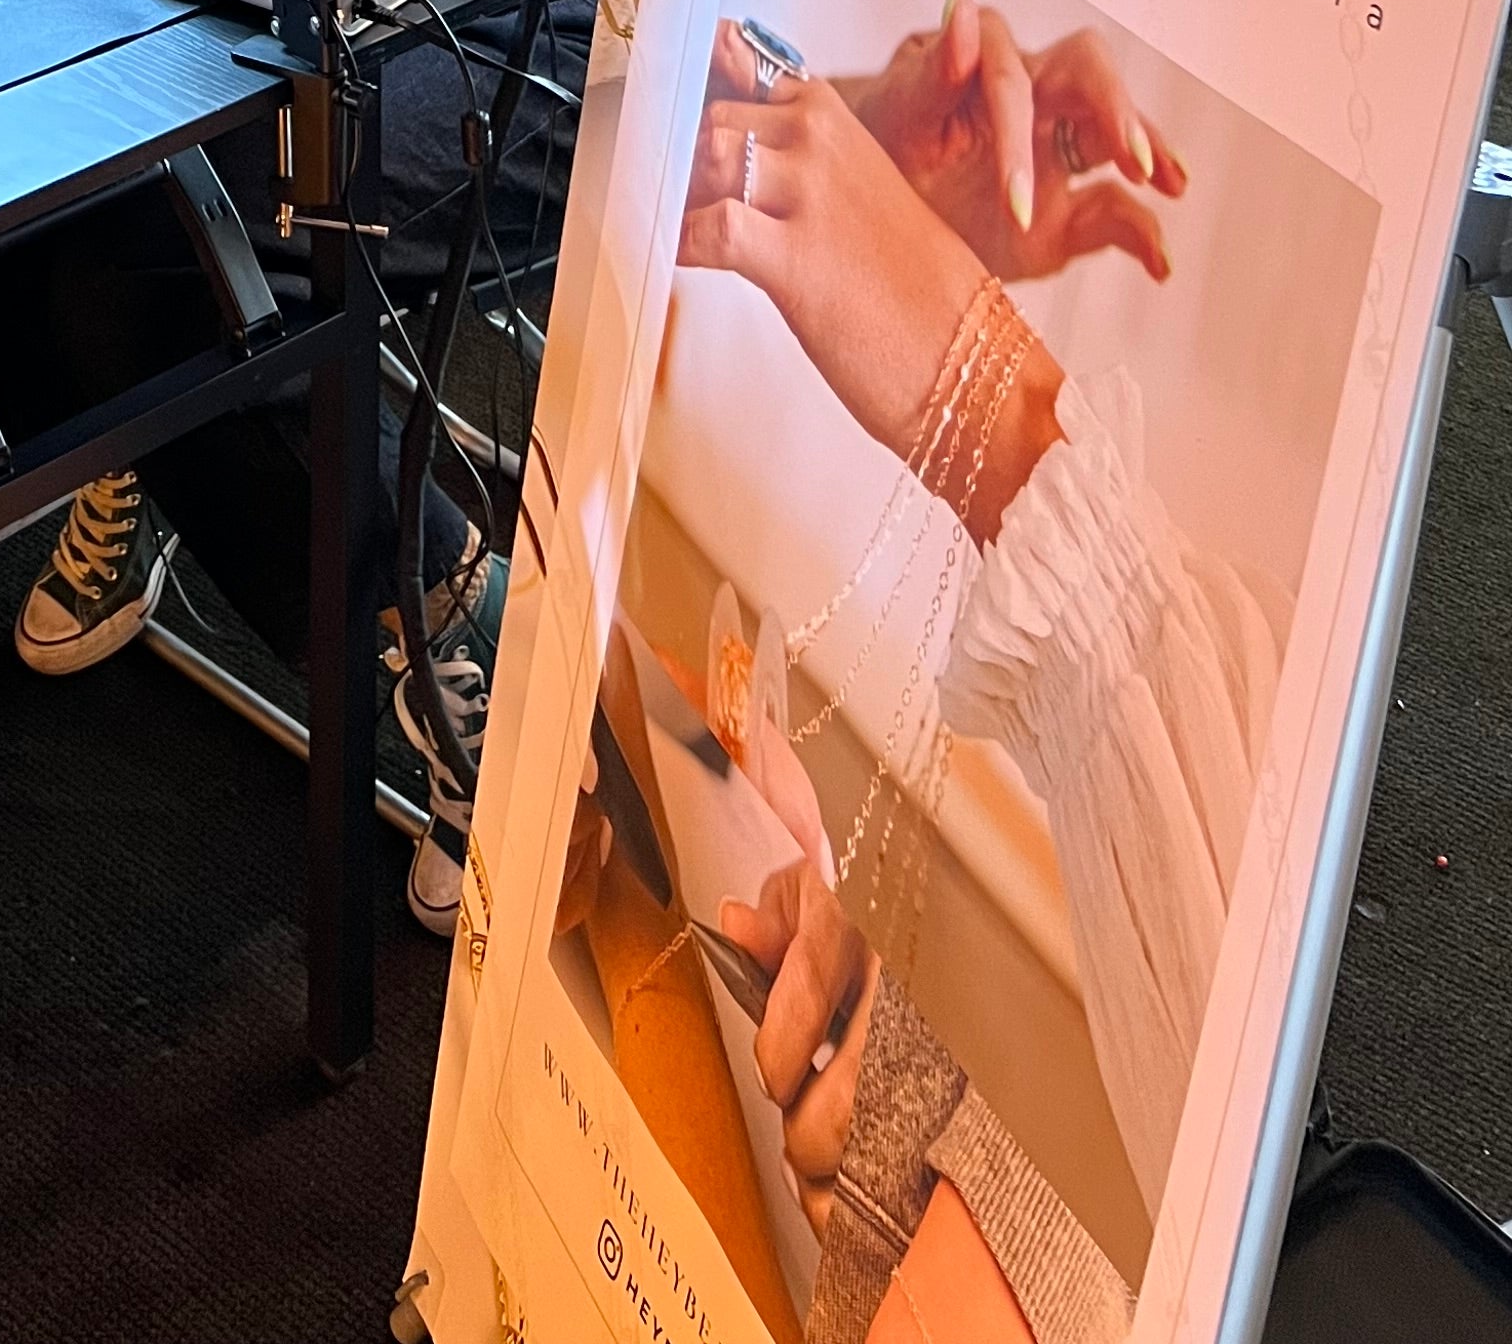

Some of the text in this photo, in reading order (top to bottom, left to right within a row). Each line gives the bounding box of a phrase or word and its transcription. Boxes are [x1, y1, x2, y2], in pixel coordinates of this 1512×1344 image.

[1366, 3, 1384, 32] a
[544, 1041, 722, 1344] WWW.THEHEYBE
[626, 1273, 672, 1344] HEY
